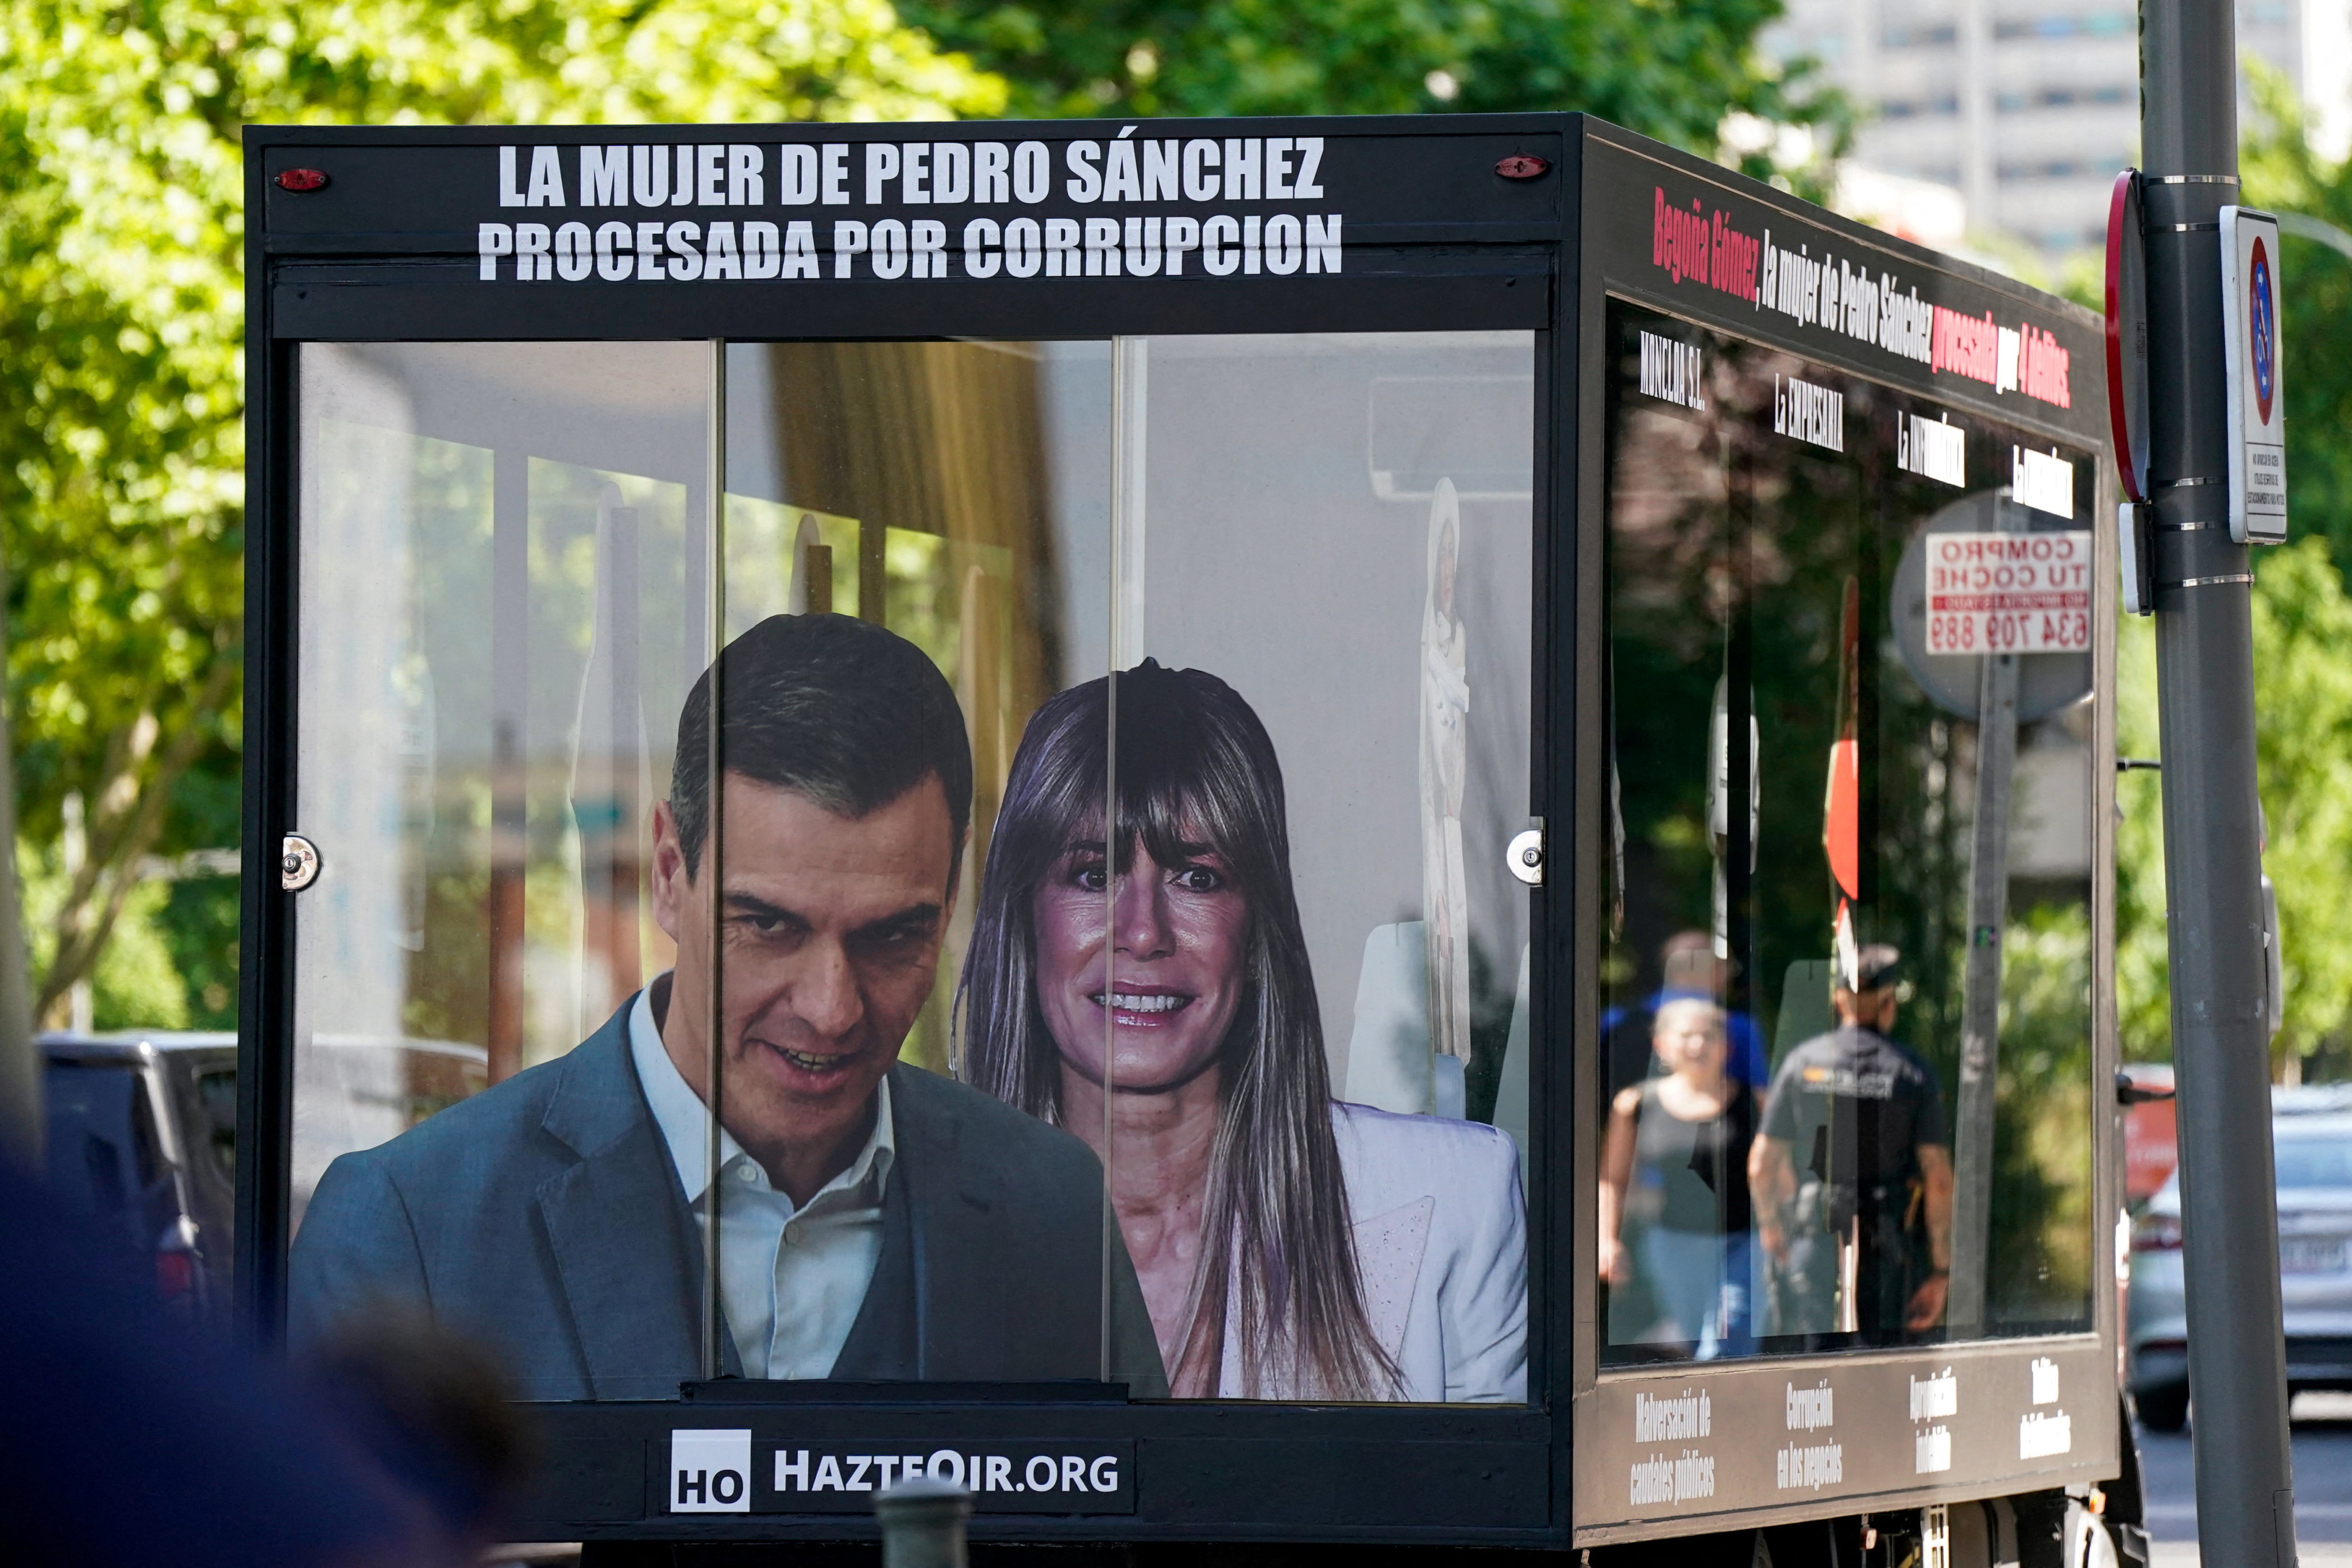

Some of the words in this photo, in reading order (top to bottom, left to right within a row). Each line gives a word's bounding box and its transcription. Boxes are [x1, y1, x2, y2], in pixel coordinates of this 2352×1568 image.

[499, 145, 565, 207] LA
[580, 143, 763, 207] MUJER
[781, 142, 849, 206] DE
[865, 141, 1050, 205] PEDRO
[1066, 125, 1324, 203] SÁNCHEZ
[478, 221, 821, 281] PROCESADA
[834, 219, 948, 280] POR
[964, 214, 1342, 280] CORRUPCION
[1653, 187, 1709, 284] Begoña
[1711, 210, 1760, 312] Gómez,
[1762, 229, 1776, 310] la
[1778, 244, 1820, 327] mujer
[1821, 253, 1839, 331] de
[1839, 259, 1879, 345] Pedro
[1879, 272, 1933, 364] Sánchez
[1640, 330, 1686, 405] MONCLOA
[1688, 346, 1705, 411] S.L.
[1774, 373, 1786, 435] La
[1788, 377, 1844, 453] EMPRESARIA
[1897, 410, 1909, 470] La
[1635, 1387, 1697, 1443] Malversación
[1699, 1388, 1711, 1437] de
[1786, 1378, 1833, 1432] Corrupción
[678, 1469, 743, 1504] HO
[1630, 1453, 1673, 1506] caudales
[1674, 1449, 1714, 1505] públicos
[1777, 1448, 1788, 1489] en
[1789, 1441, 1803, 1488] los
[1803, 1437, 1843, 1492] negocios
